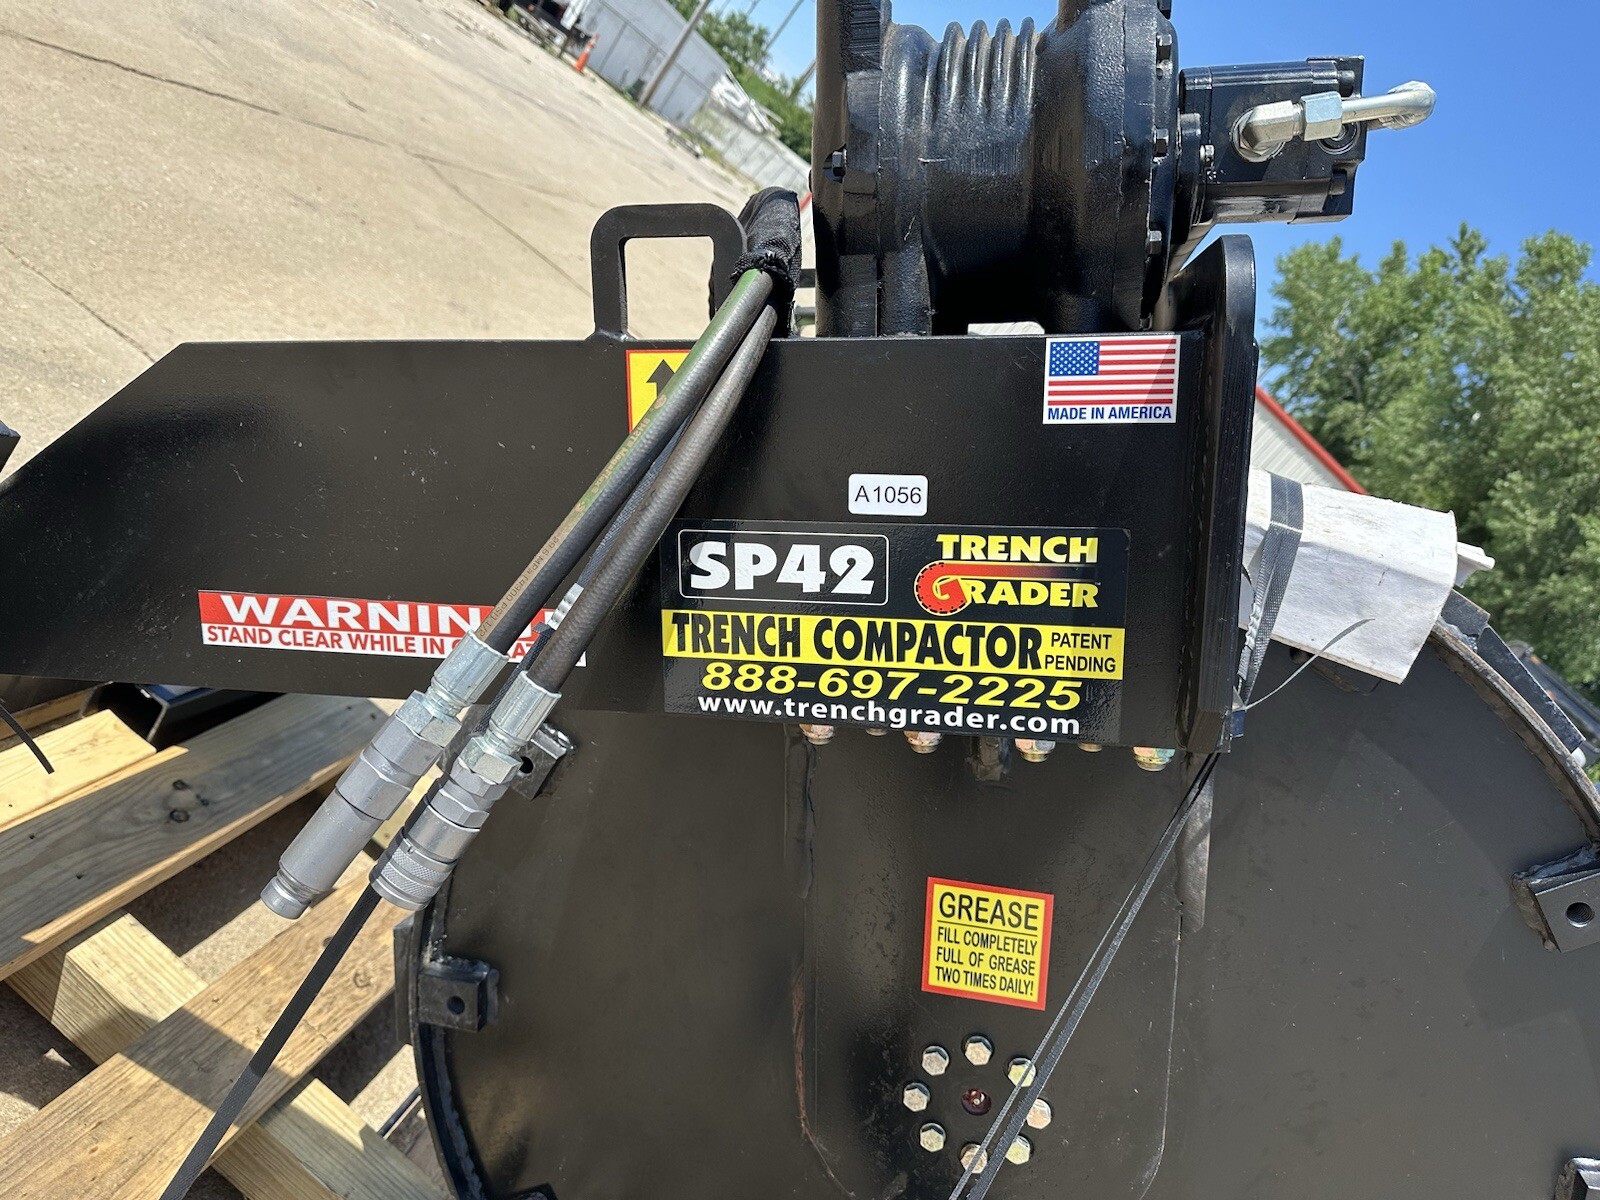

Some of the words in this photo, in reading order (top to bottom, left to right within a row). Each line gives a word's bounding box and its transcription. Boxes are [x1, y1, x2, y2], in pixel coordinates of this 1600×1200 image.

[1048, 407, 1087, 420] MADE
[1091, 407, 1105, 420] IN
[1108, 406, 1172, 419] AMERICA
[854, 485, 922, 504] A1056
[936, 533, 1099, 563] TRENCH
[688, 540, 875, 595] SP42
[914, 560, 1099, 616] GRADER
[220, 595, 556, 639] WARNIN
[207, 625, 272, 645] STAND
[278, 629, 343, 649] CLEAR
[347, 633, 416, 653] WHILE
[422, 637, 445, 655] IN
[671, 613, 800, 658] TRENCH
[813, 617, 1042, 671] COMPACTOR
[1051, 632, 1112, 650] PATENT
[1045, 655, 1116, 673] PENDING
[701, 661, 1083, 710] 888-697-2225
[698, 696, 1080, 735] www.trenchgrader.com
[939, 891, 1039, 931] GREASE
[937, 926, 960, 944] FILL
[963, 930, 1038, 956] COMPLETELY
[936, 946, 963, 965] FULL
[968, 951, 985, 968] OF
[989, 954, 1036, 976] GREASE
[935, 966, 961, 984] TWO
[963, 970, 997, 989] TIMES
[999, 976, 1034, 996] DAILY!
